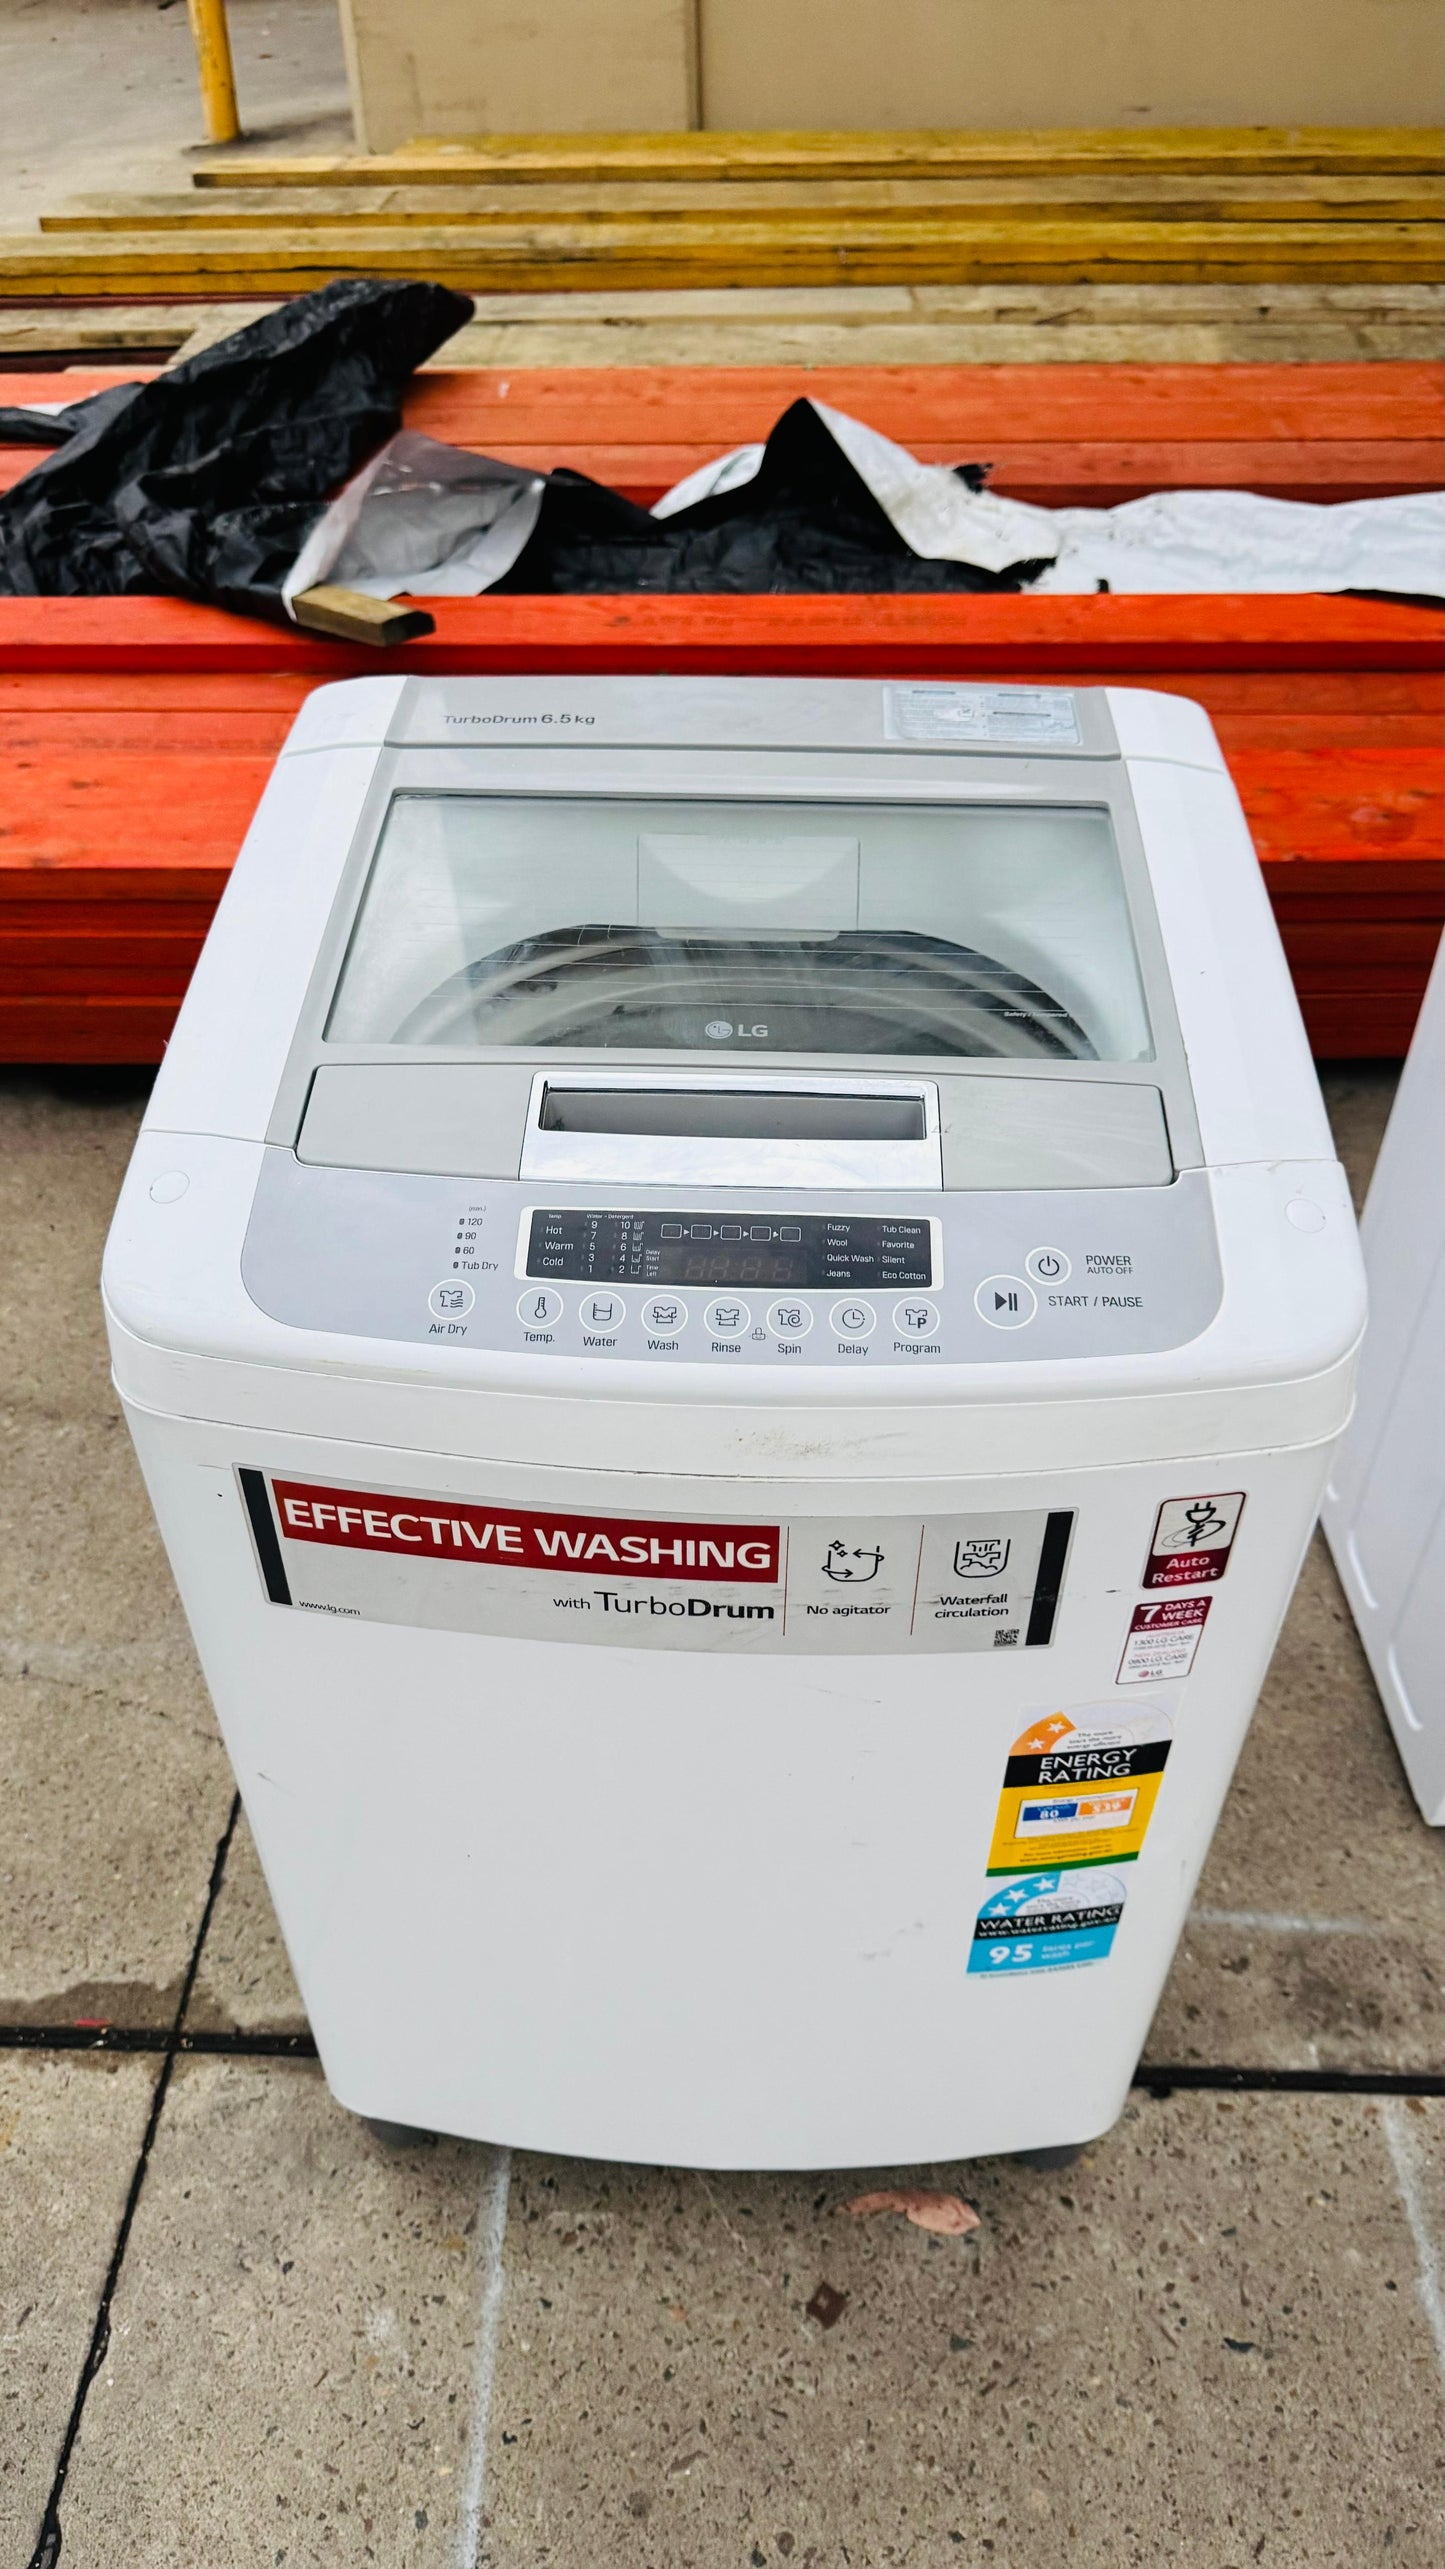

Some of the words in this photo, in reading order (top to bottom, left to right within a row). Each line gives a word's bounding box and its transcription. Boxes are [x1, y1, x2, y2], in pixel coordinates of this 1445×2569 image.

[444, 714, 537, 725] TurboDrum
[541, 713, 571, 724] 6.5
[575, 714, 596, 725] kg
[738, 1024, 768, 1038] LG
[468, 1217, 483, 1226] 120
[620, 1221, 631, 1229] 10
[546, 1226, 563, 1234] Hot
[827, 1223, 850, 1233] Fuzzy
[882, 1225, 897, 1234] Tub
[898, 1226, 921, 1234] Clean
[465, 1232, 477, 1240] 90
[591, 1231, 597, 1240] 7
[621, 1232, 628, 1240] 8
[545, 1242, 574, 1251] Warm
[589, 1242, 596, 1251] 5
[620, 1243, 627, 1251] 6
[827, 1238, 848, 1247] Wool
[882, 1240, 915, 1249] Favorite
[463, 1246, 475, 1254] 60
[542, 1257, 564, 1266] Cold
[588, 1253, 595, 1261] 3
[619, 1254, 626, 1262] 4
[827, 1253, 850, 1263] Quick
[851, 1254, 875, 1263] Wash
[882, 1255, 905, 1264] Silent
[1086, 1255, 1132, 1266] POWER
[462, 1261, 480, 1270] Tub
[481, 1261, 499, 1272] Dry
[618, 1265, 625, 1273] 2
[1087, 1266, 1114, 1274] AUTO
[1115, 1266, 1134, 1274] OFF
[827, 1269, 851, 1278] Jeans
[882, 1271, 898, 1280] Eco
[899, 1271, 926, 1280] Cotton
[1048, 1295, 1089, 1307] START
[1102, 1296, 1143, 1308] PAUSE
[429, 1323, 446, 1334] Air
[447, 1324, 468, 1336] Dry
[524, 1331, 556, 1344] Temp.
[583, 1336, 617, 1347] Water
[648, 1339, 679, 1351] Wash
[711, 1342, 741, 1353] Rinse
[777, 1343, 802, 1355] Spin
[838, 1343, 869, 1356] Delay
[893, 1342, 941, 1355] Program
[283, 1497, 524, 1554] EFFECTIVE
[534, 1527, 771, 1569] WASHING
[1166, 1556, 1210, 1569] Auto
[1152, 1567, 1219, 1584] Restart
[554, 1595, 591, 1610] with
[594, 1590, 775, 1620] TurboDrum
[940, 1593, 1008, 1606] Waterfall
[298, 1599, 361, 1616] www.lg.com
[807, 1605, 828, 1615] No
[832, 1604, 891, 1617] agitator
[1165, 1601, 1195, 1611] DAYS
[935, 1606, 1009, 1619] circulation
[1140, 1605, 1162, 1623] 7
[1162, 1609, 1204, 1621] WEEK
[1134, 1621, 1180, 1630] CUSTOMER
[1181, 1618, 1203, 1626] CARE
[1041, 1748, 1137, 1770] ENERGY
[1038, 1763, 1131, 1784] RATING
[1040, 1809, 1060, 1819] 80
[979, 1915, 1045, 1930] WATER
[1051, 1906, 1120, 1924] RATING
[989, 1943, 1034, 1964] 95
